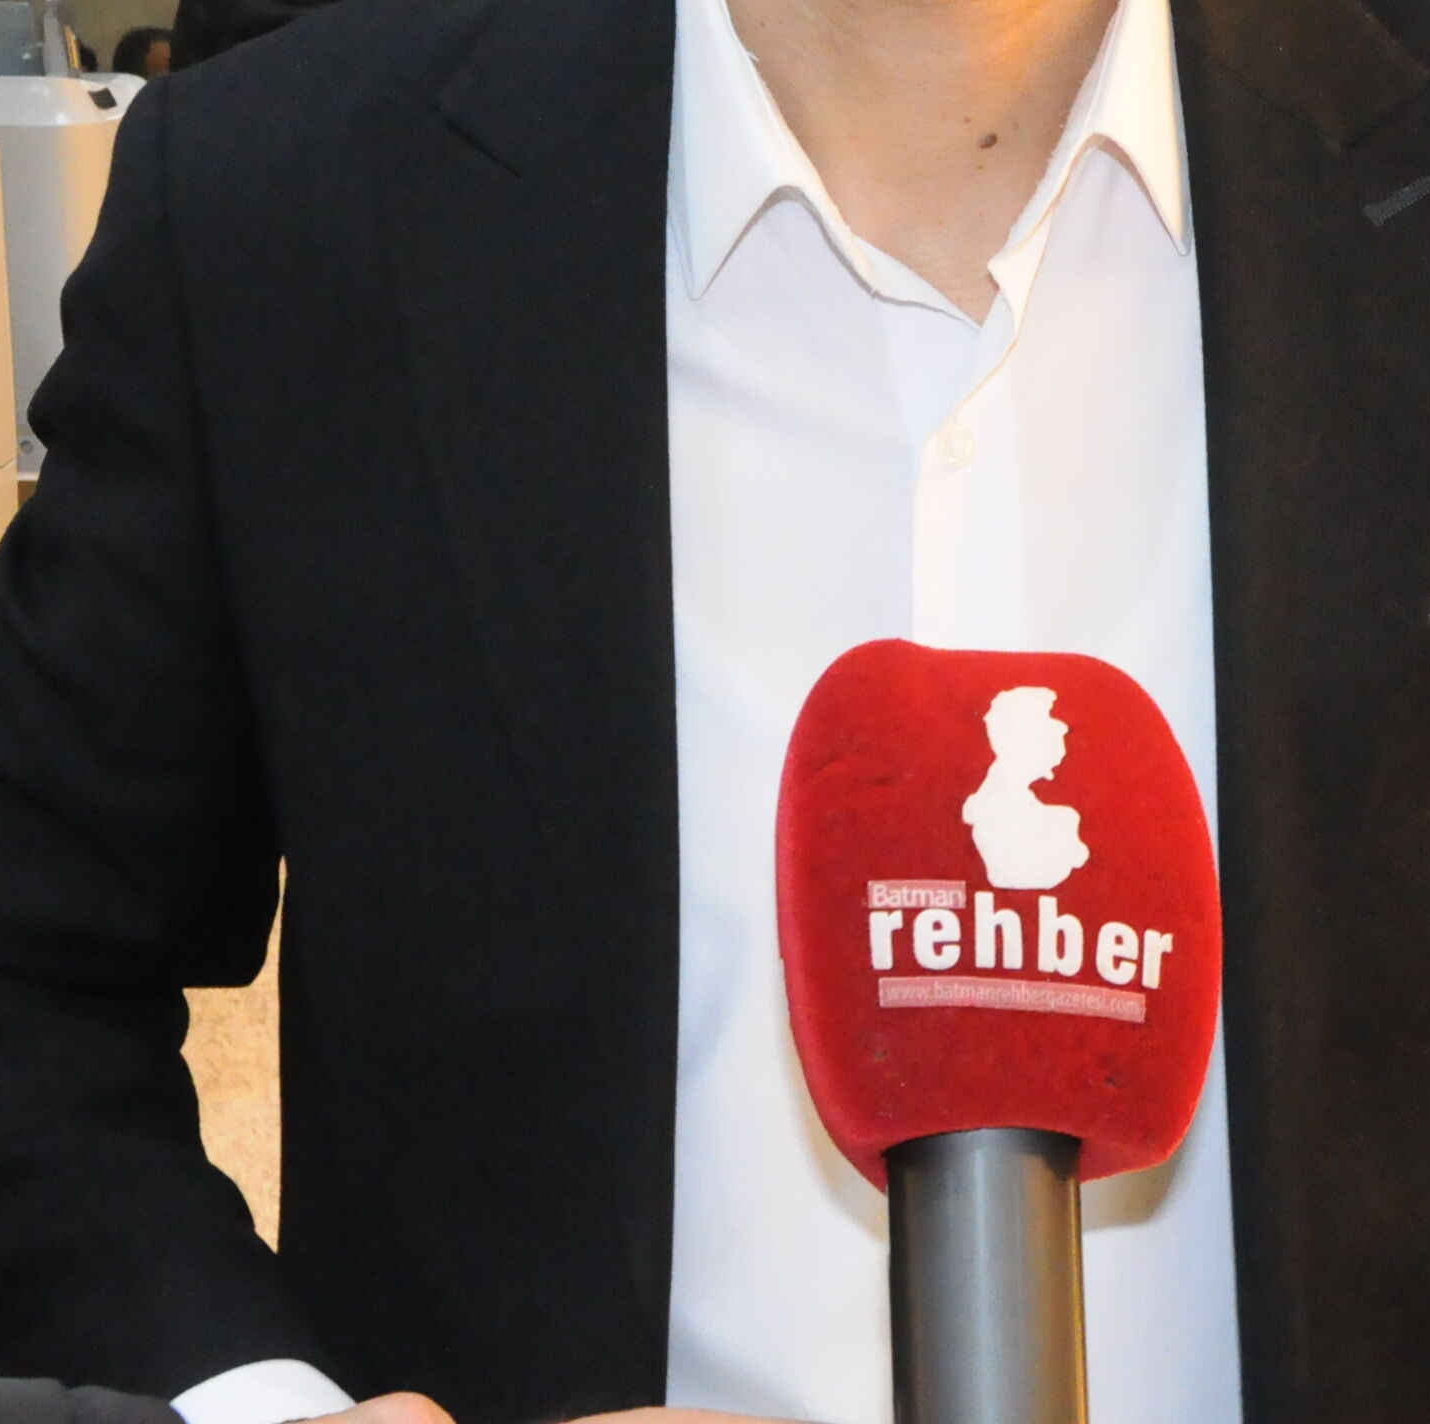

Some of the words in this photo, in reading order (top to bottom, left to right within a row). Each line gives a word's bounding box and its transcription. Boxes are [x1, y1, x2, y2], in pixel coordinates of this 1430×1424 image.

[873, 884, 964, 907] Batman
[870, 891, 1173, 990] rehber
[886, 981, 1142, 1015] www.batmanrehbergazetesi.com
